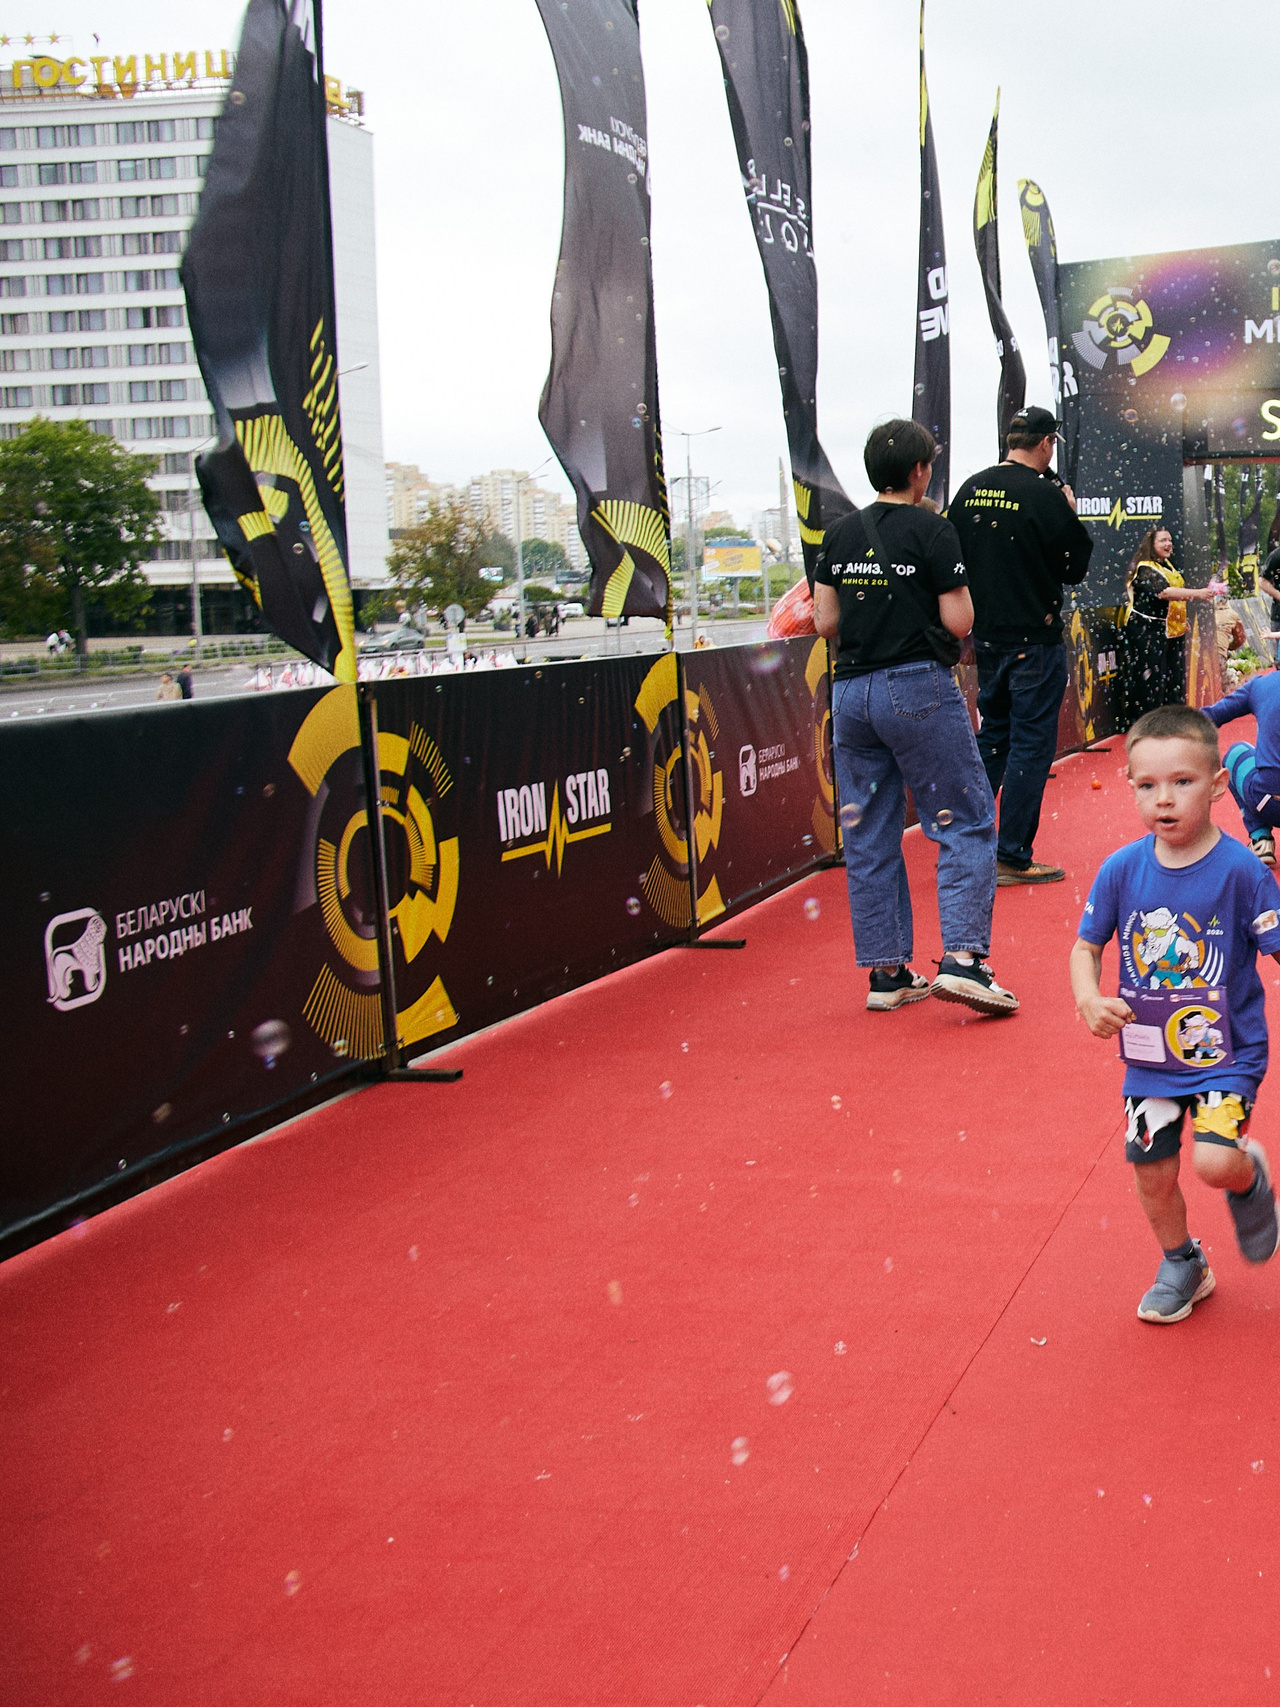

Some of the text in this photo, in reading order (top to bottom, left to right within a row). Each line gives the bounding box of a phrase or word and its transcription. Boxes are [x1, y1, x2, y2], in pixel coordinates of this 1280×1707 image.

[12, 48, 234, 88] ГОСТИНИЦ
[974, 488, 1006, 498] НОВЫЕ
[964, 498, 1020, 511] ГРАНИ ТЕБЯ
[1076, 496, 1163, 515] IRON STAR
[842, 578, 869, 586] МИНСК
[497, 768, 611, 842] IRON STAR
[115, 889, 206, 939] БЕЛАРУСКІ
[117, 906, 254, 973] НАРОДНЫ БАНК
[1206, 928, 1224, 936] 2026
